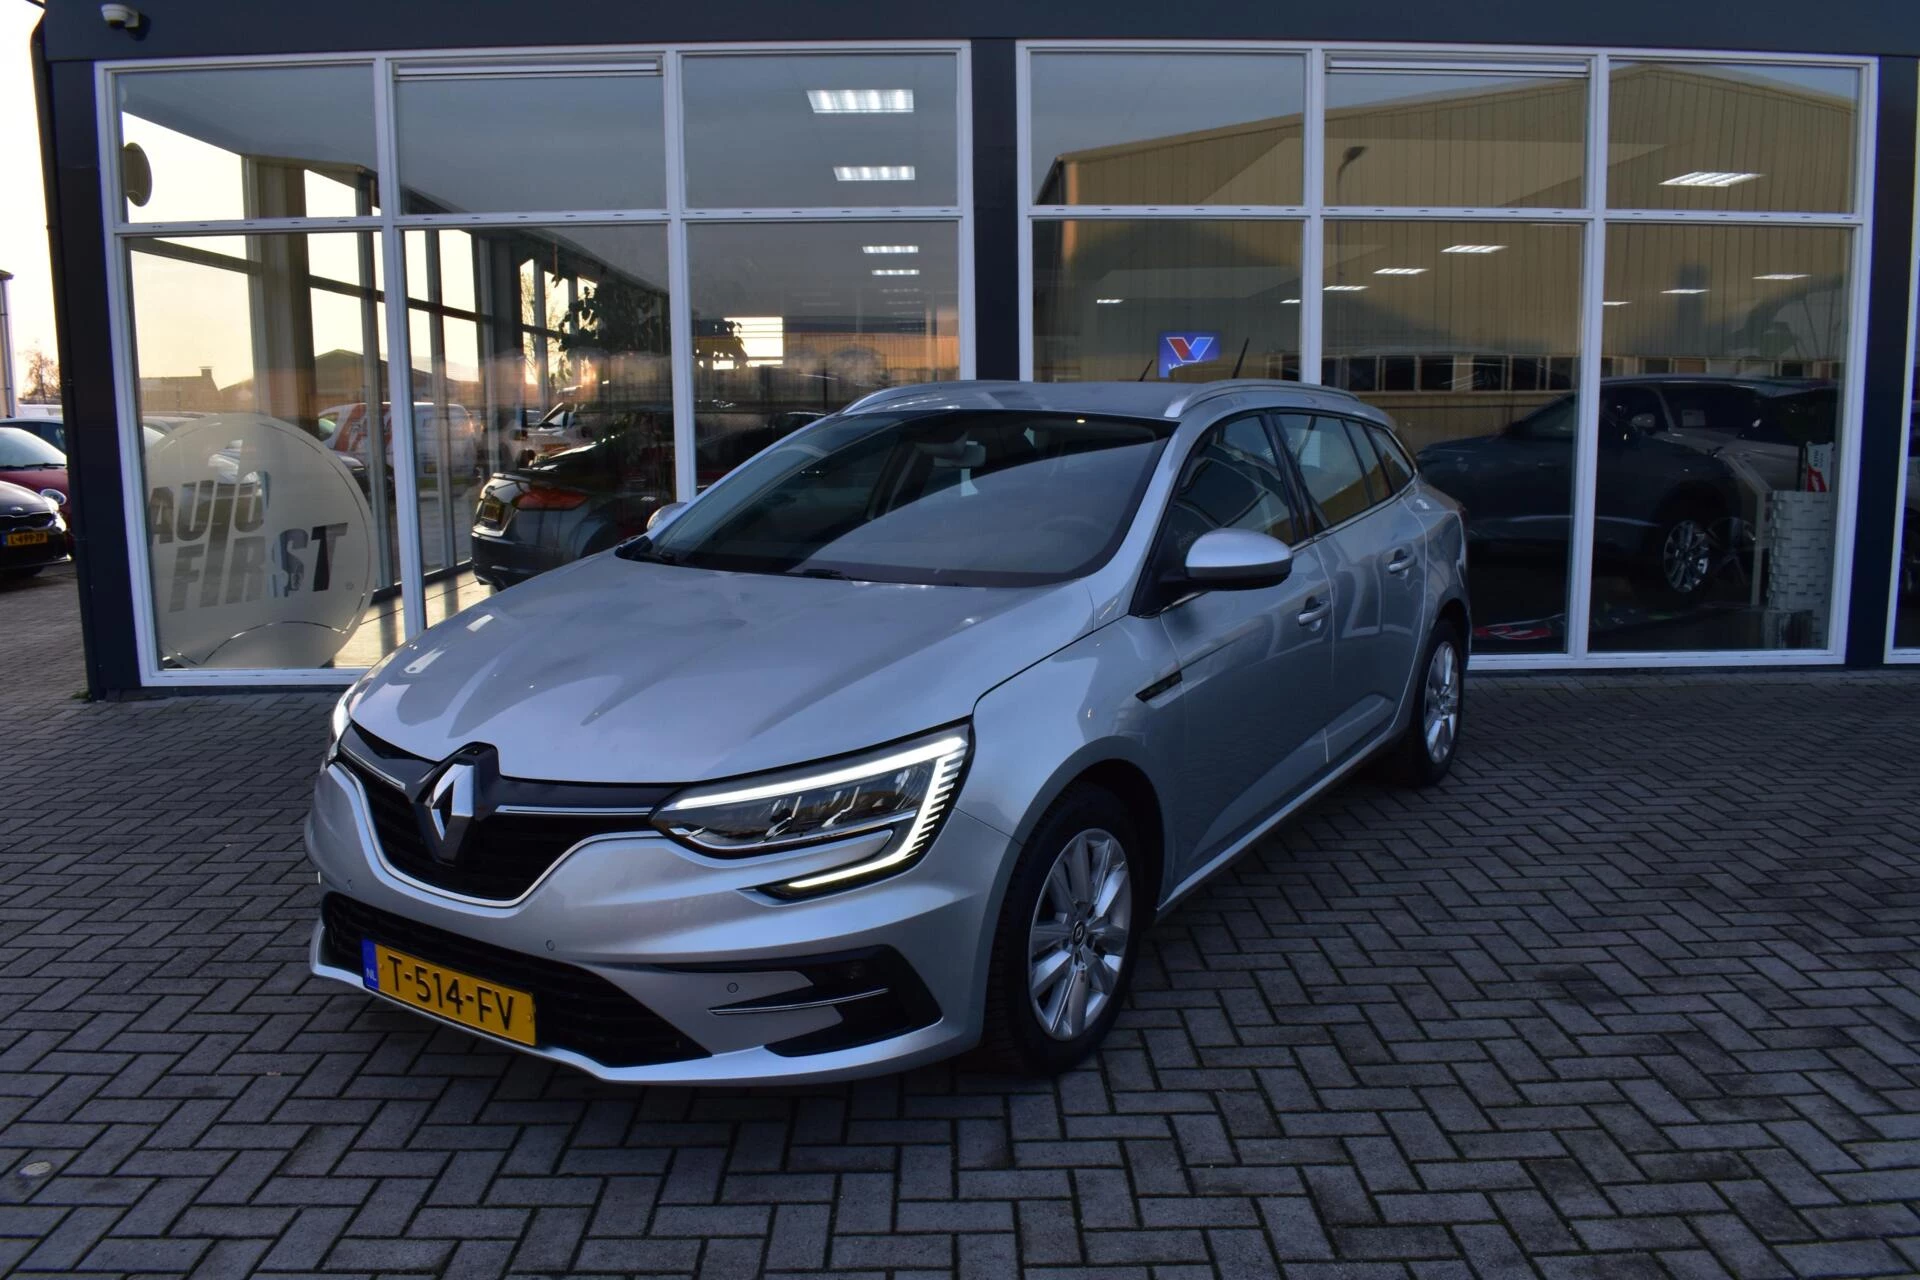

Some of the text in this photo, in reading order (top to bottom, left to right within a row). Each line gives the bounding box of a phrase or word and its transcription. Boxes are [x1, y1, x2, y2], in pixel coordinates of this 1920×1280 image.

[149, 471, 271, 543] AUTO
[168, 522, 348, 612] FIRST
[366, 967, 377, 982] NL
[387, 954, 514, 1032] T-514-FV
